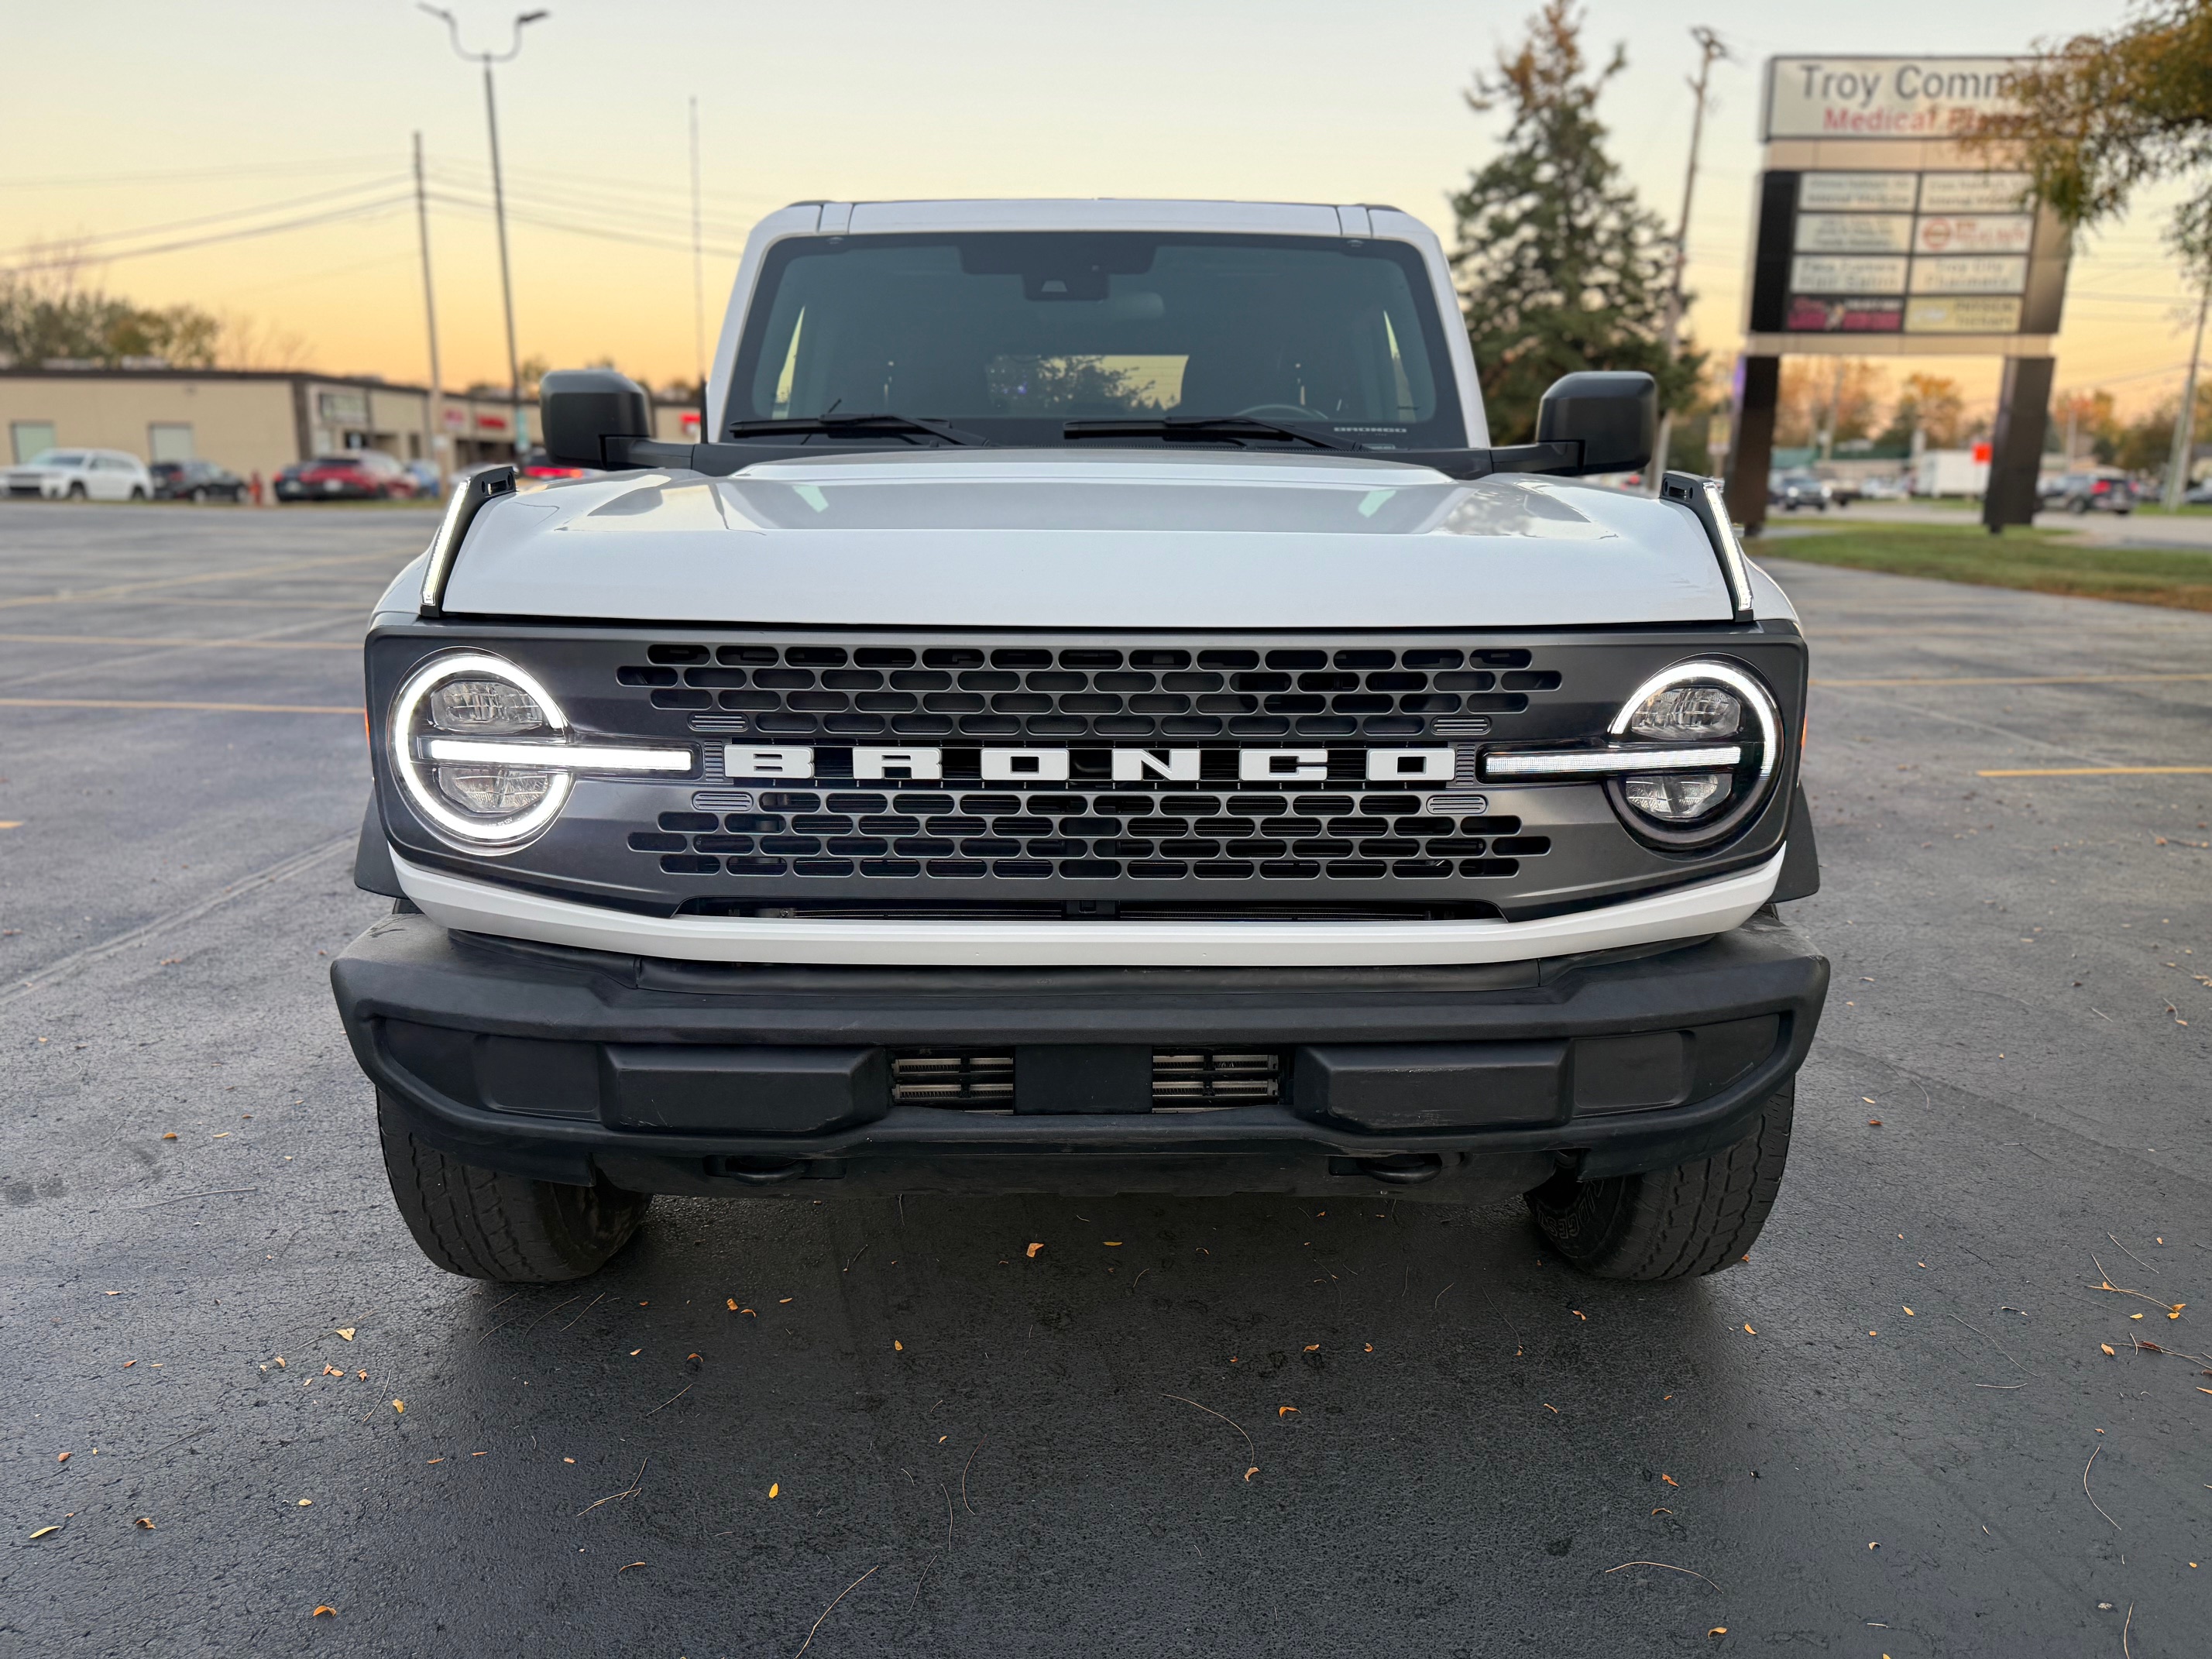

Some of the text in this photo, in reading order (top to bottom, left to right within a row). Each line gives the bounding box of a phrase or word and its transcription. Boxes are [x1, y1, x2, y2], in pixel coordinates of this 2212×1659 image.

[1799, 65, 1881, 107] Troy
[1823, 105, 1937, 131] Medical
[725, 744, 1455, 781] BRONCO
